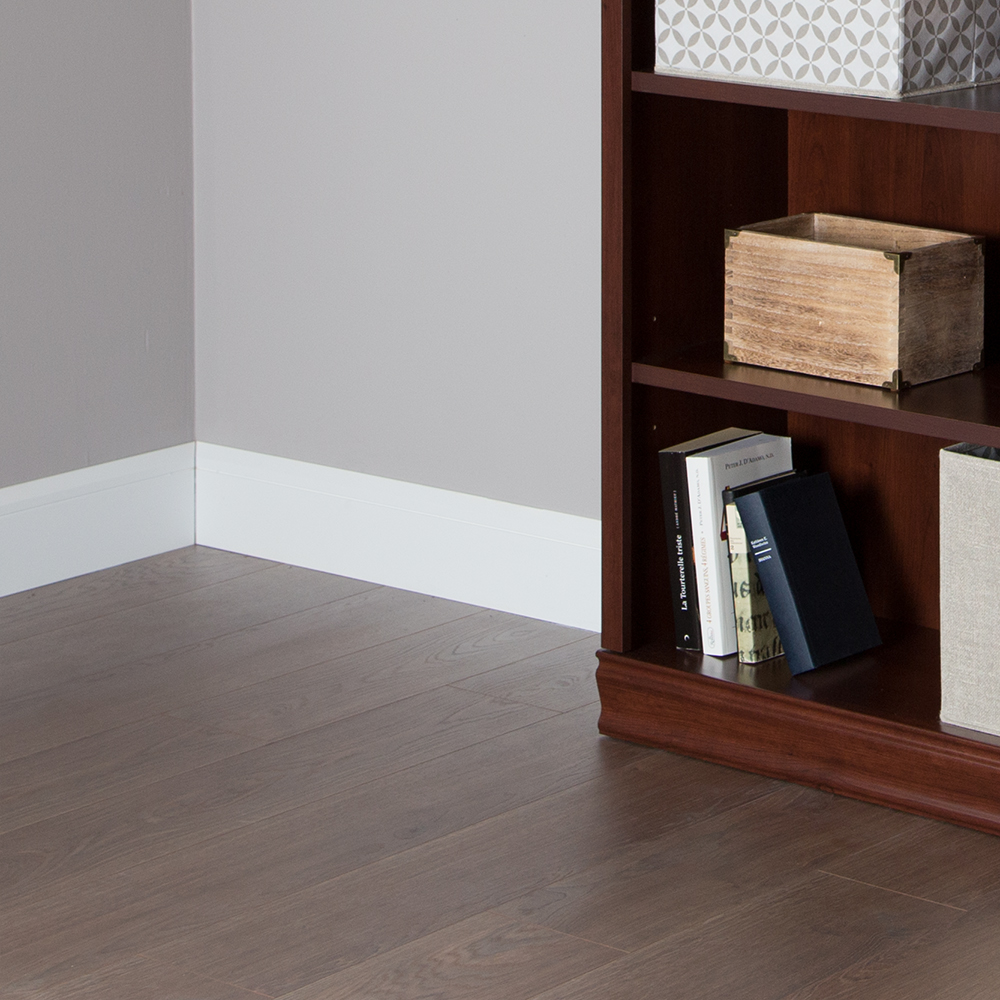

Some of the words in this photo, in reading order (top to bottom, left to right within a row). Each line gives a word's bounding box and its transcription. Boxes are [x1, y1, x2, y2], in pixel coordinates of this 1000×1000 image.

[675, 534, 683, 555] triste
[677, 556, 687, 598] Tourterelle
[680, 600, 688, 611] La
